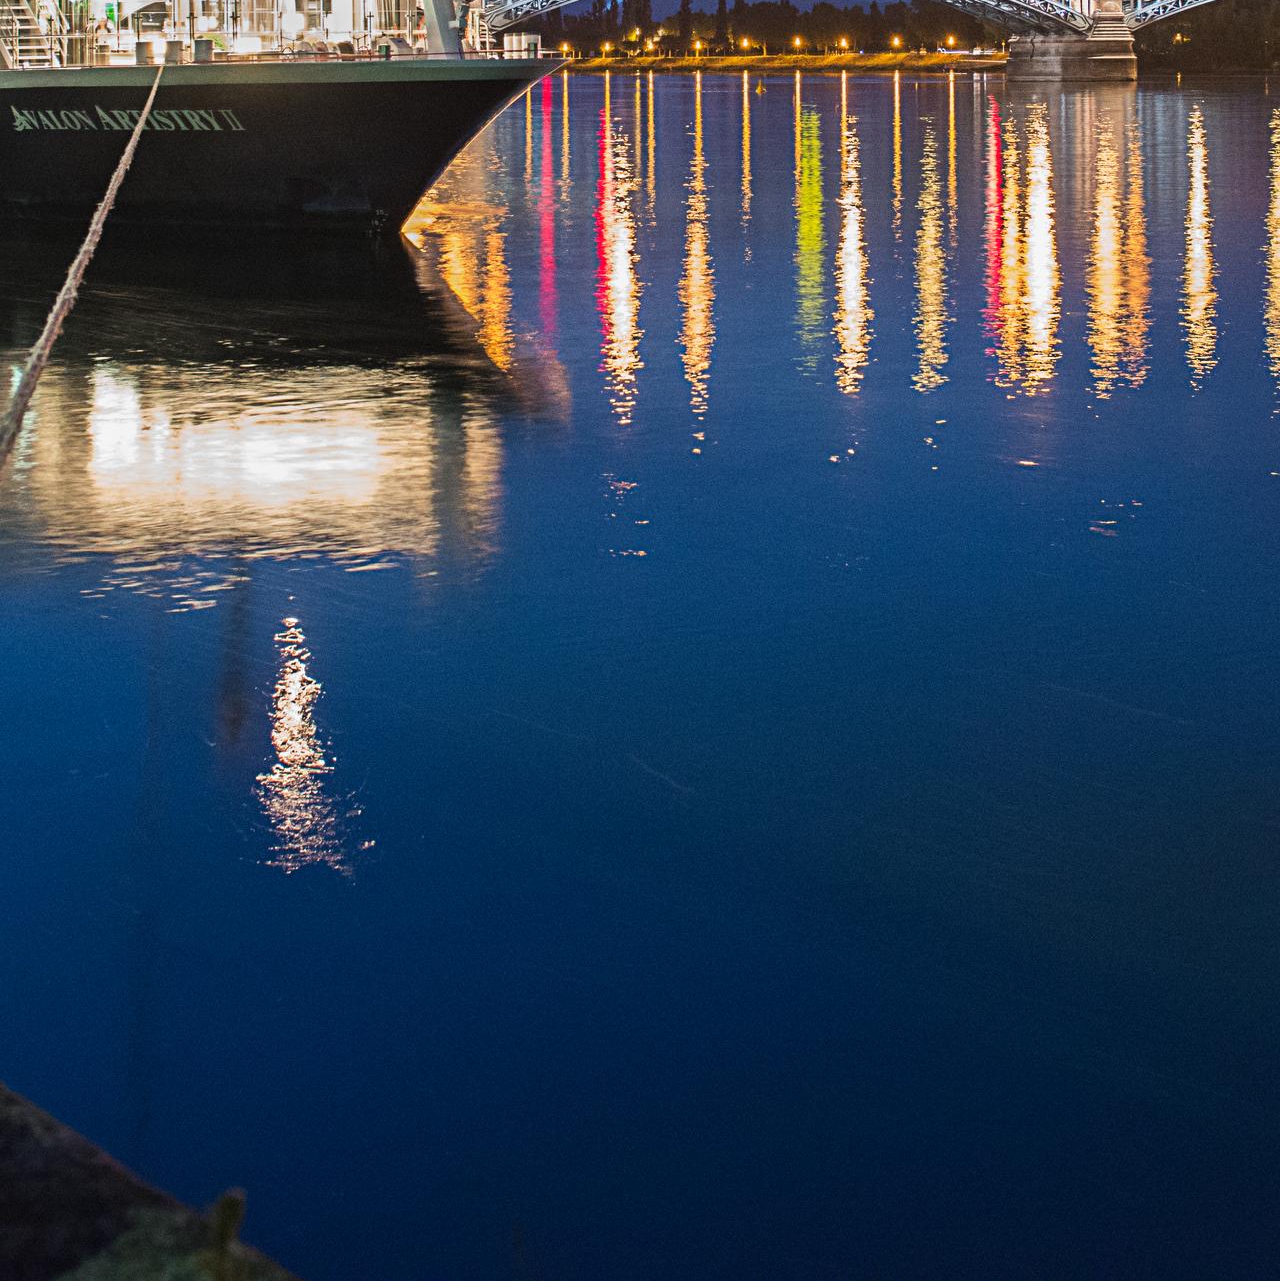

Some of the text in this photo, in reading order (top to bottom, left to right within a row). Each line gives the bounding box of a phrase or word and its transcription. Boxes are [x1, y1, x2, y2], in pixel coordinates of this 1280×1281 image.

[10, 105, 247, 131] AVALON ARTISTRY II
